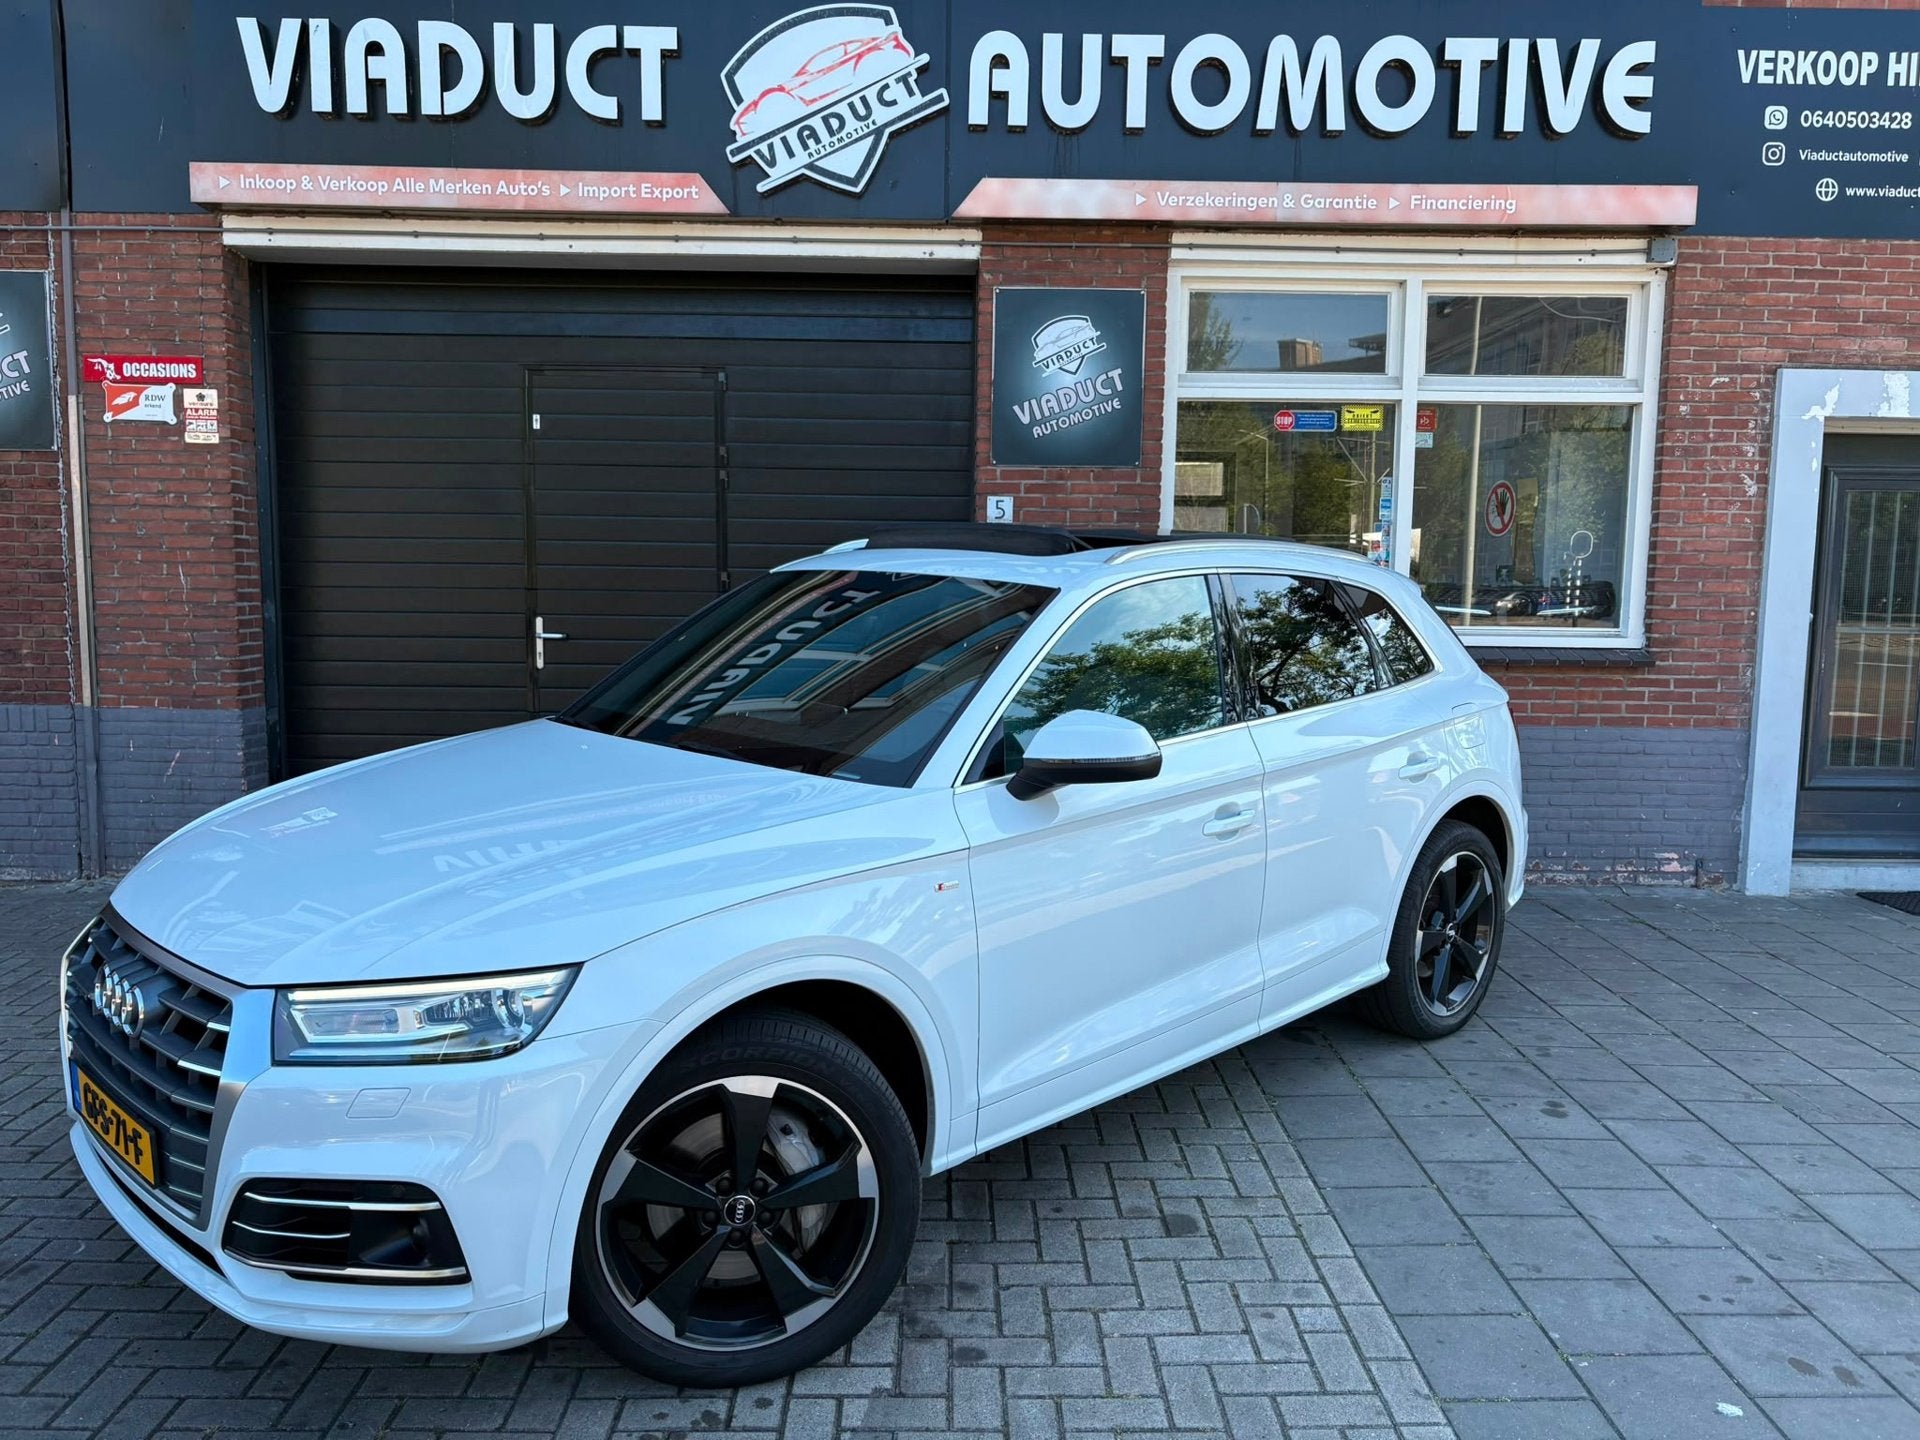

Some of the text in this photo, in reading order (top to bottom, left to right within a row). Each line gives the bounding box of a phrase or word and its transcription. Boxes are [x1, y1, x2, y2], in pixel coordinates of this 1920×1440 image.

[236, 17, 1657, 134] VIADUCT AUTOMOTIVE
[1737, 49, 1920, 87] VERKOOP HI
[753, 71, 917, 169] VIADUCT
[1800, 110, 1912, 129] 0640503428
[808, 119, 878, 159] AUTOMOTIVE
[1799, 149, 1909, 163] Viaductautomotive
[239, 174, 550, 196] Inkoop & Verkoop Alle Merken Auto's
[578, 182, 699, 202] Import Export
[1156, 191, 1377, 210] Verzekeringen & Garantie
[1410, 195, 1517, 214] Financiering
[1042, 337, 1096, 370] VIADUCT
[0, 350, 31, 379] CT
[122, 362, 197, 378] OCCASIONS
[0, 380, 31, 399] TIVE
[1012, 367, 1124, 425] VIADUCT
[186, 408, 218, 417] ALARM
[1032, 397, 1122, 439] AUTOMOTIVE
[1276, 416, 1293, 425] STOP
[994, 499, 1006, 520] 5
